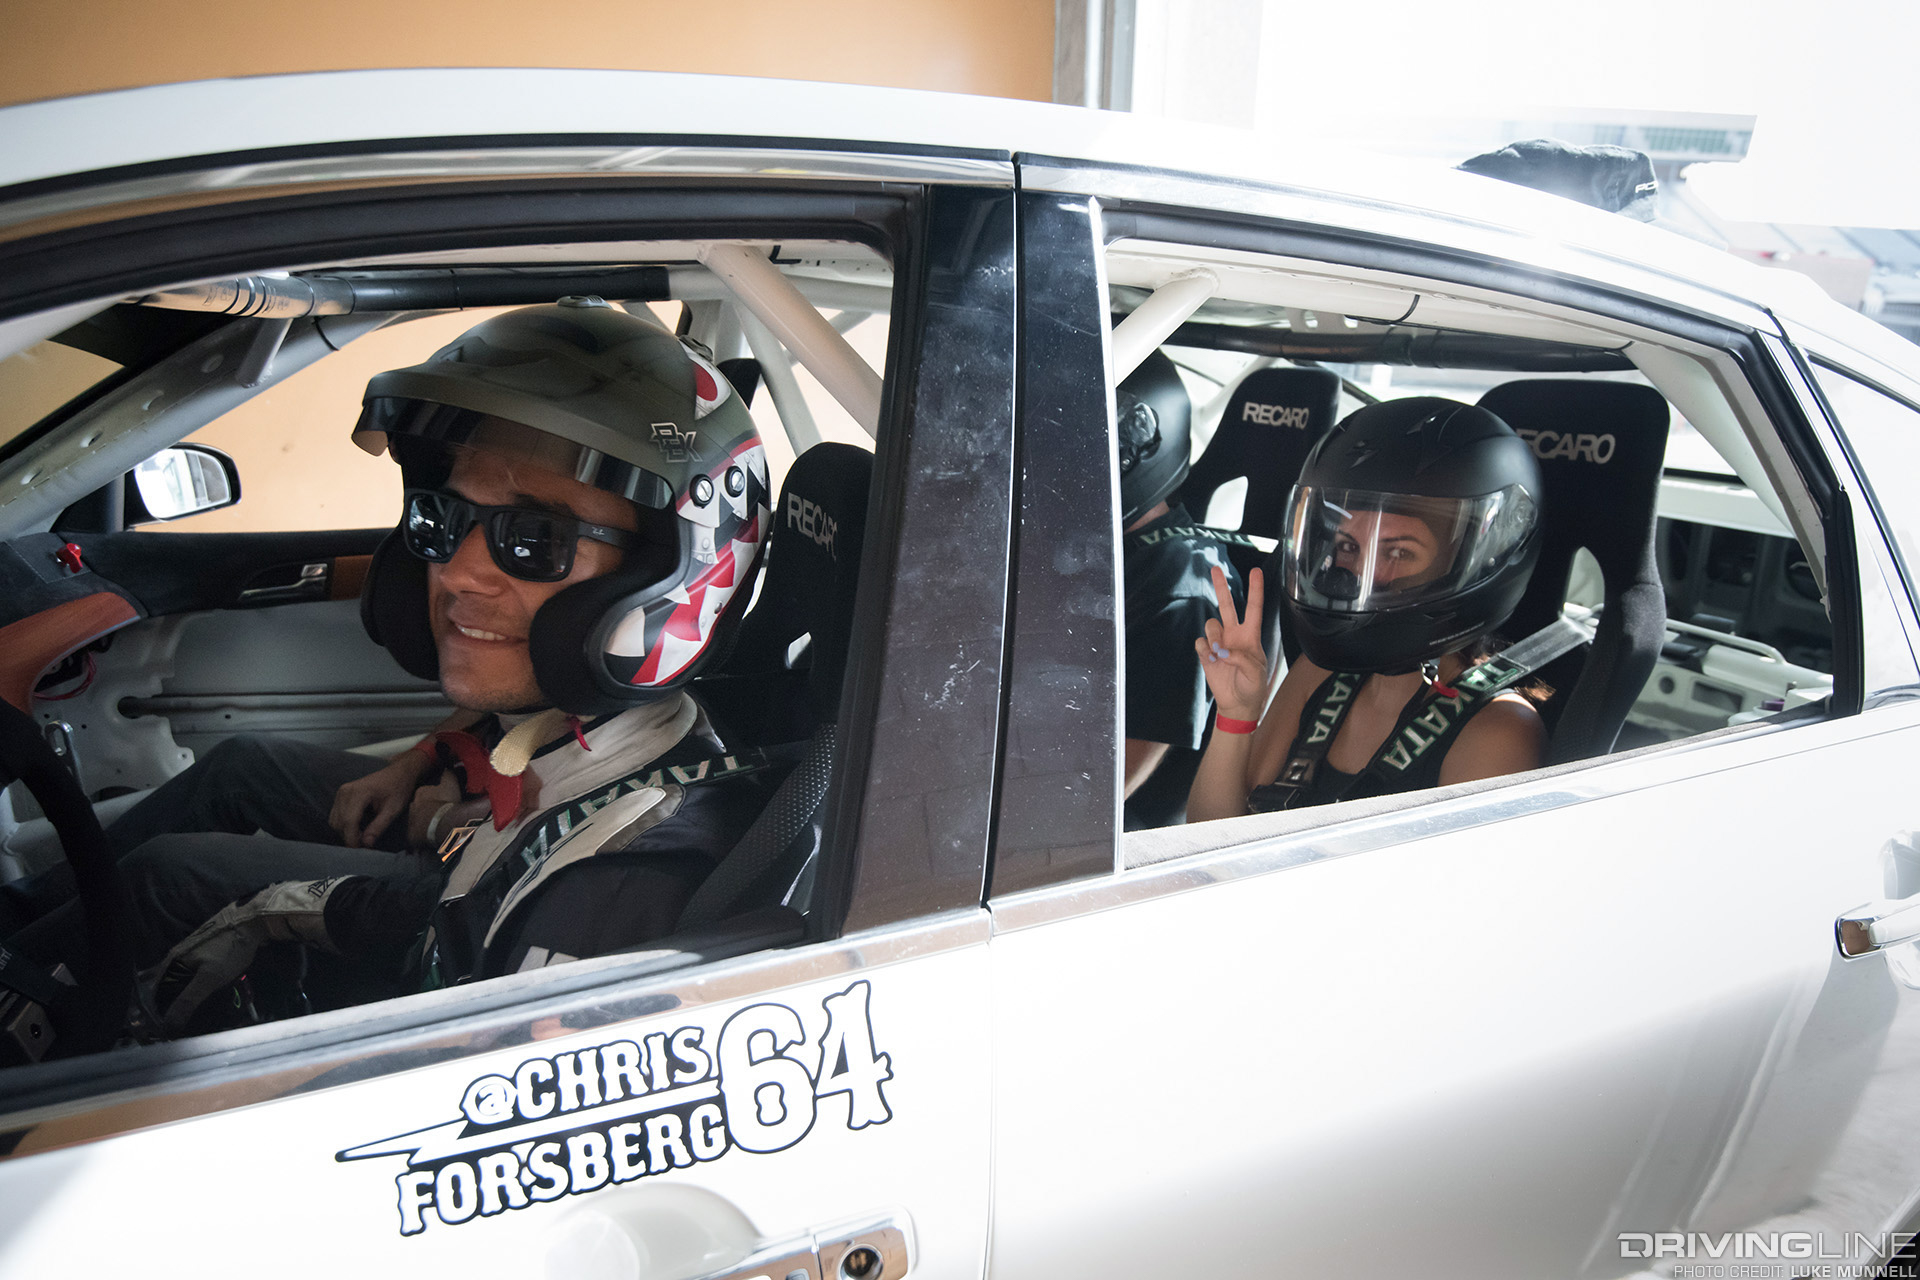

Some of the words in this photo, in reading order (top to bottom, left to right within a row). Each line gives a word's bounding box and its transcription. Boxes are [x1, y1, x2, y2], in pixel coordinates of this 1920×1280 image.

[1242, 401, 1309, 429] RECARO
[1516, 428, 1616, 464] ECARO
[1382, 663, 1518, 771] TAKATA
[459, 1025, 718, 1126] @CHRIS
[717, 979, 894, 1154] 64
[395, 1102, 731, 1237] FORSBERG
